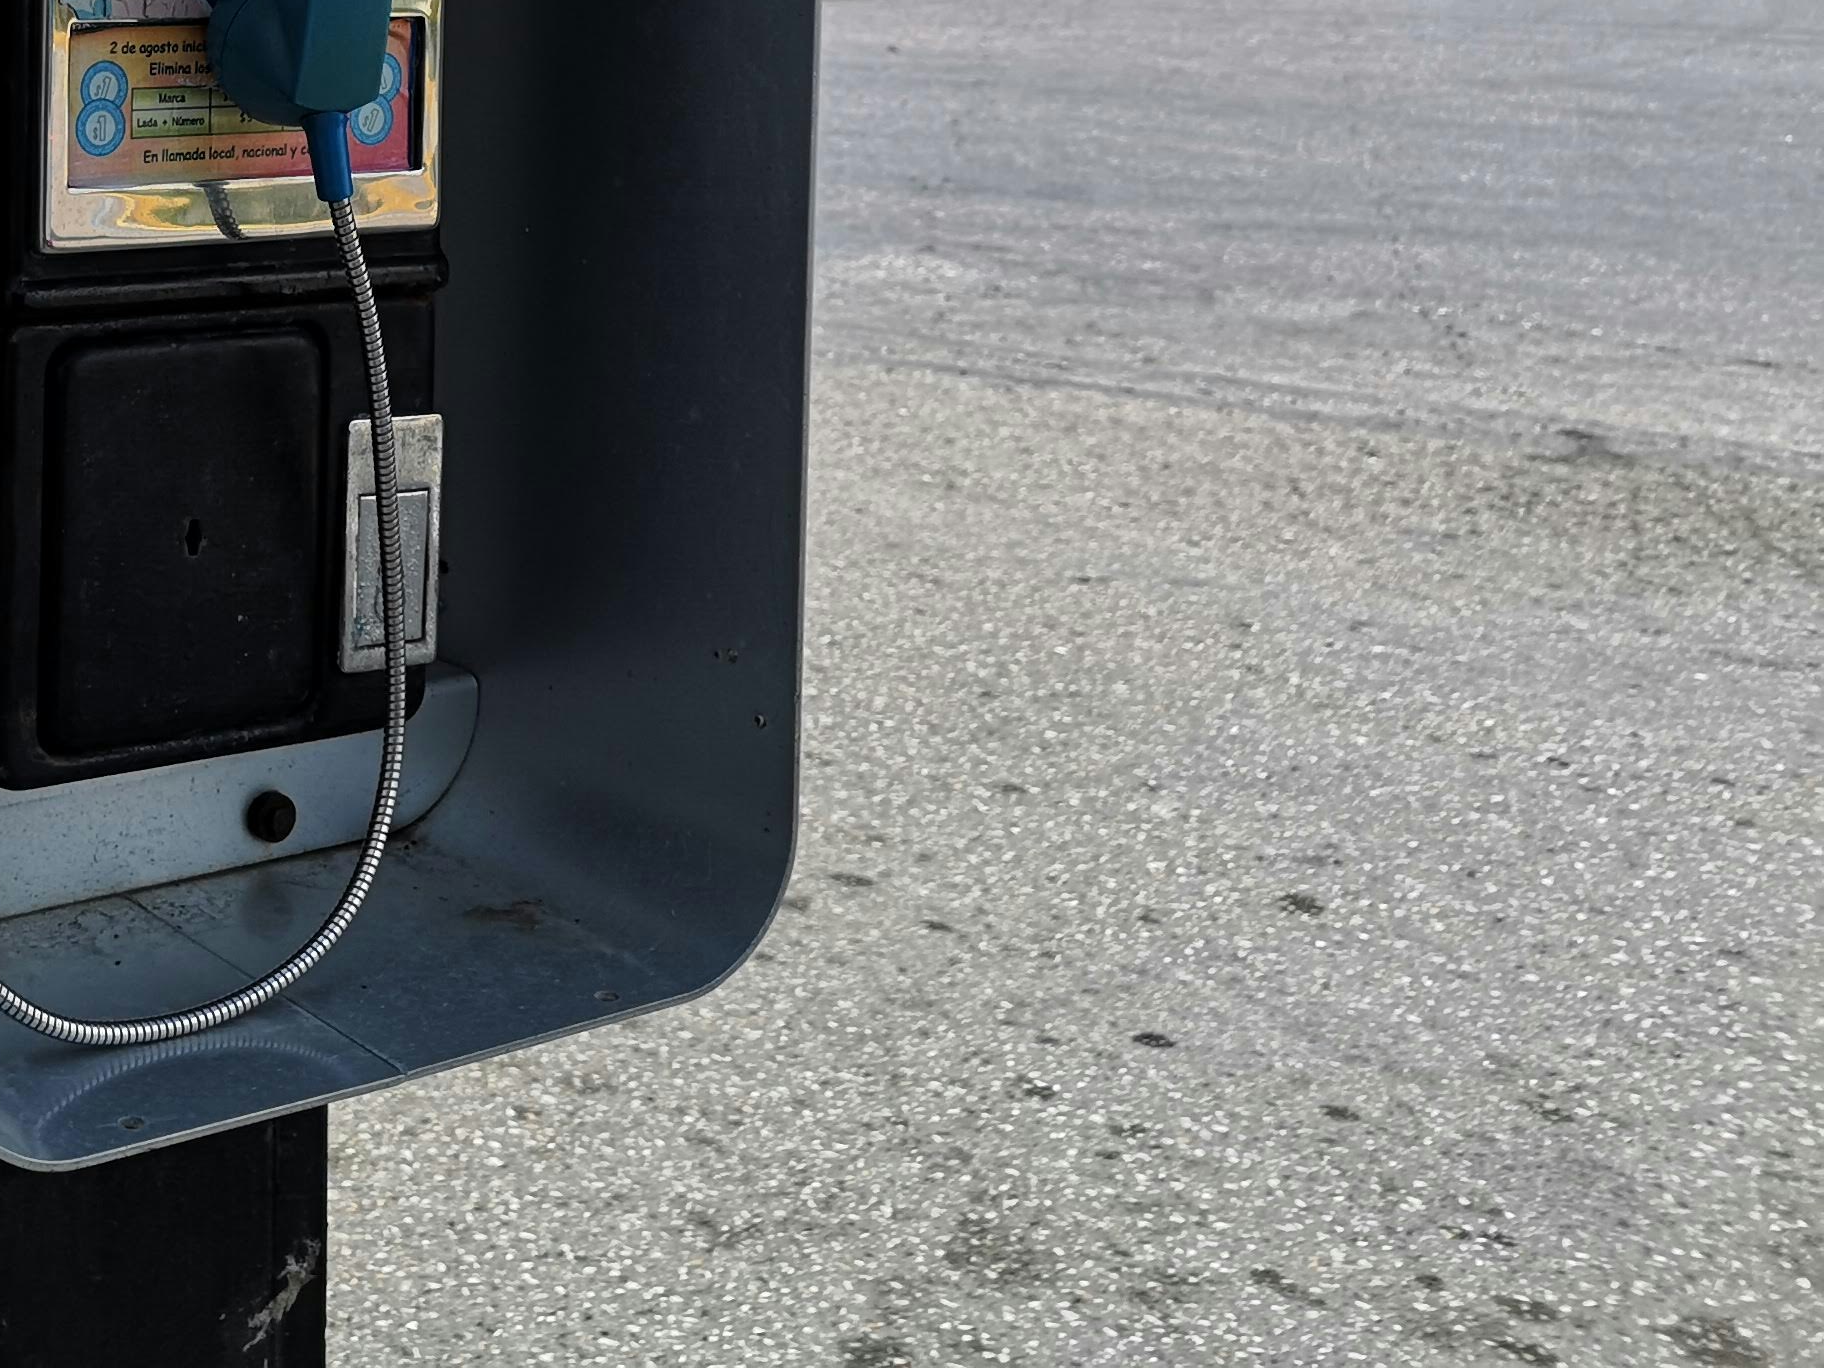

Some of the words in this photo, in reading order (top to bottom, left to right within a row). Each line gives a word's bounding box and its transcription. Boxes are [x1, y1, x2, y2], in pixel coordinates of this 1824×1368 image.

[110, 41, 118, 54] 2
[121, 41, 136, 54] de
[139, 41, 179, 57] agosto
[182, 40, 208, 52] inici
[149, 61, 191, 76] Elimina
[158, 92, 186, 104] Marca
[92, 115, 107, 142] $1
[137, 117, 158, 128] Lada
[172, 115, 204, 127] Número
[143, 150, 158, 164] En
[162, 147, 206, 162] llamada
[242, 144, 287, 158] nacional
[290, 147, 297, 157] y
